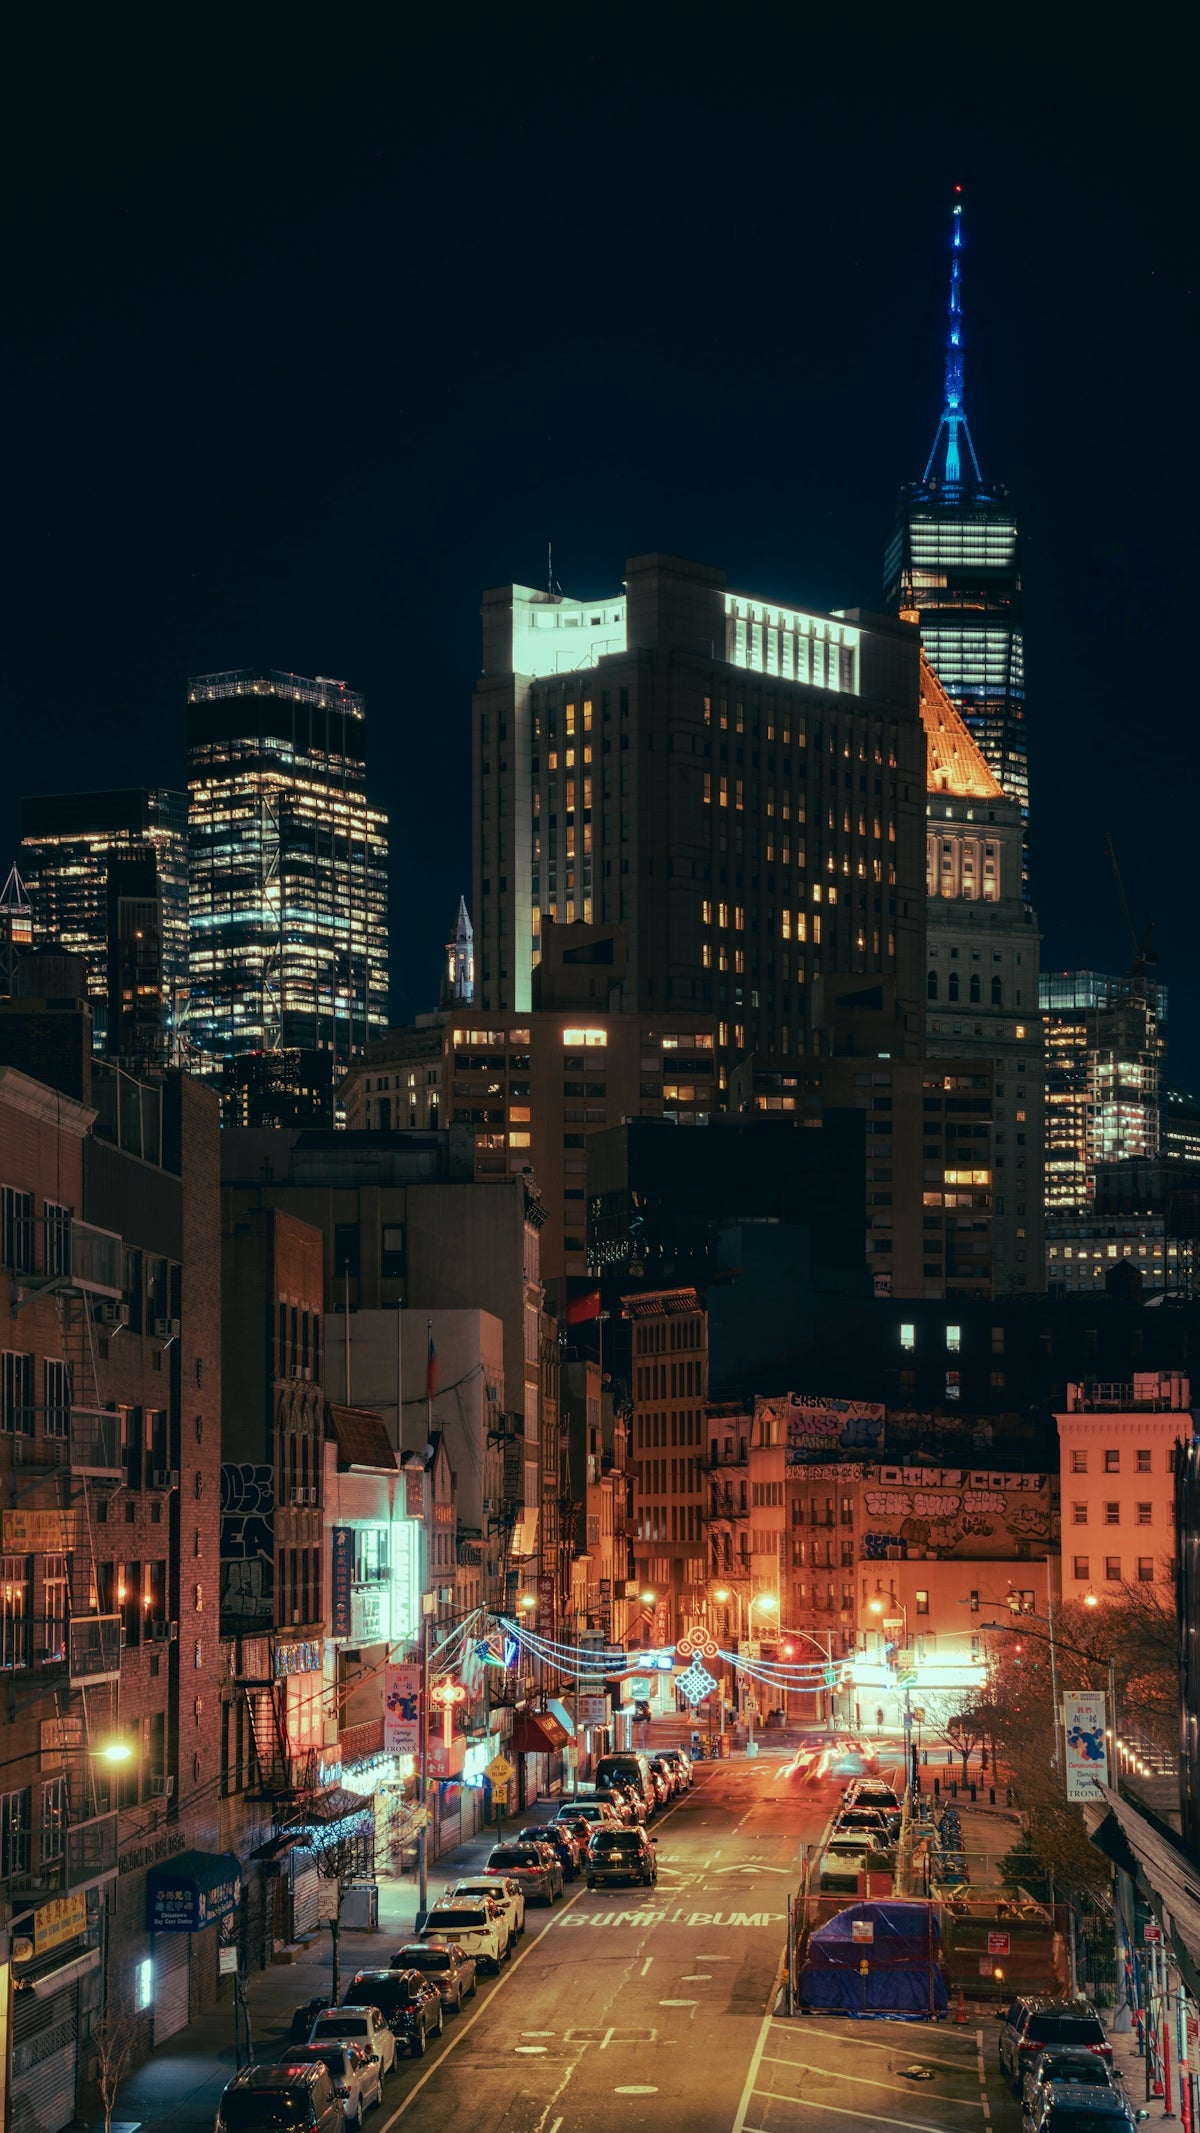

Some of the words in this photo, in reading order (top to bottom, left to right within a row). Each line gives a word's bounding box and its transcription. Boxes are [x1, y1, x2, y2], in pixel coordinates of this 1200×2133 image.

[1073, 1714, 1097, 1723] 在一起
[495, 1789, 505, 1798] 15
[1069, 1790, 1102, 1798] TRONE
[153, 1918, 164, 1926] Day
[559, 1911, 667, 1927] BUMP
[686, 1912, 787, 1927] BUMP
